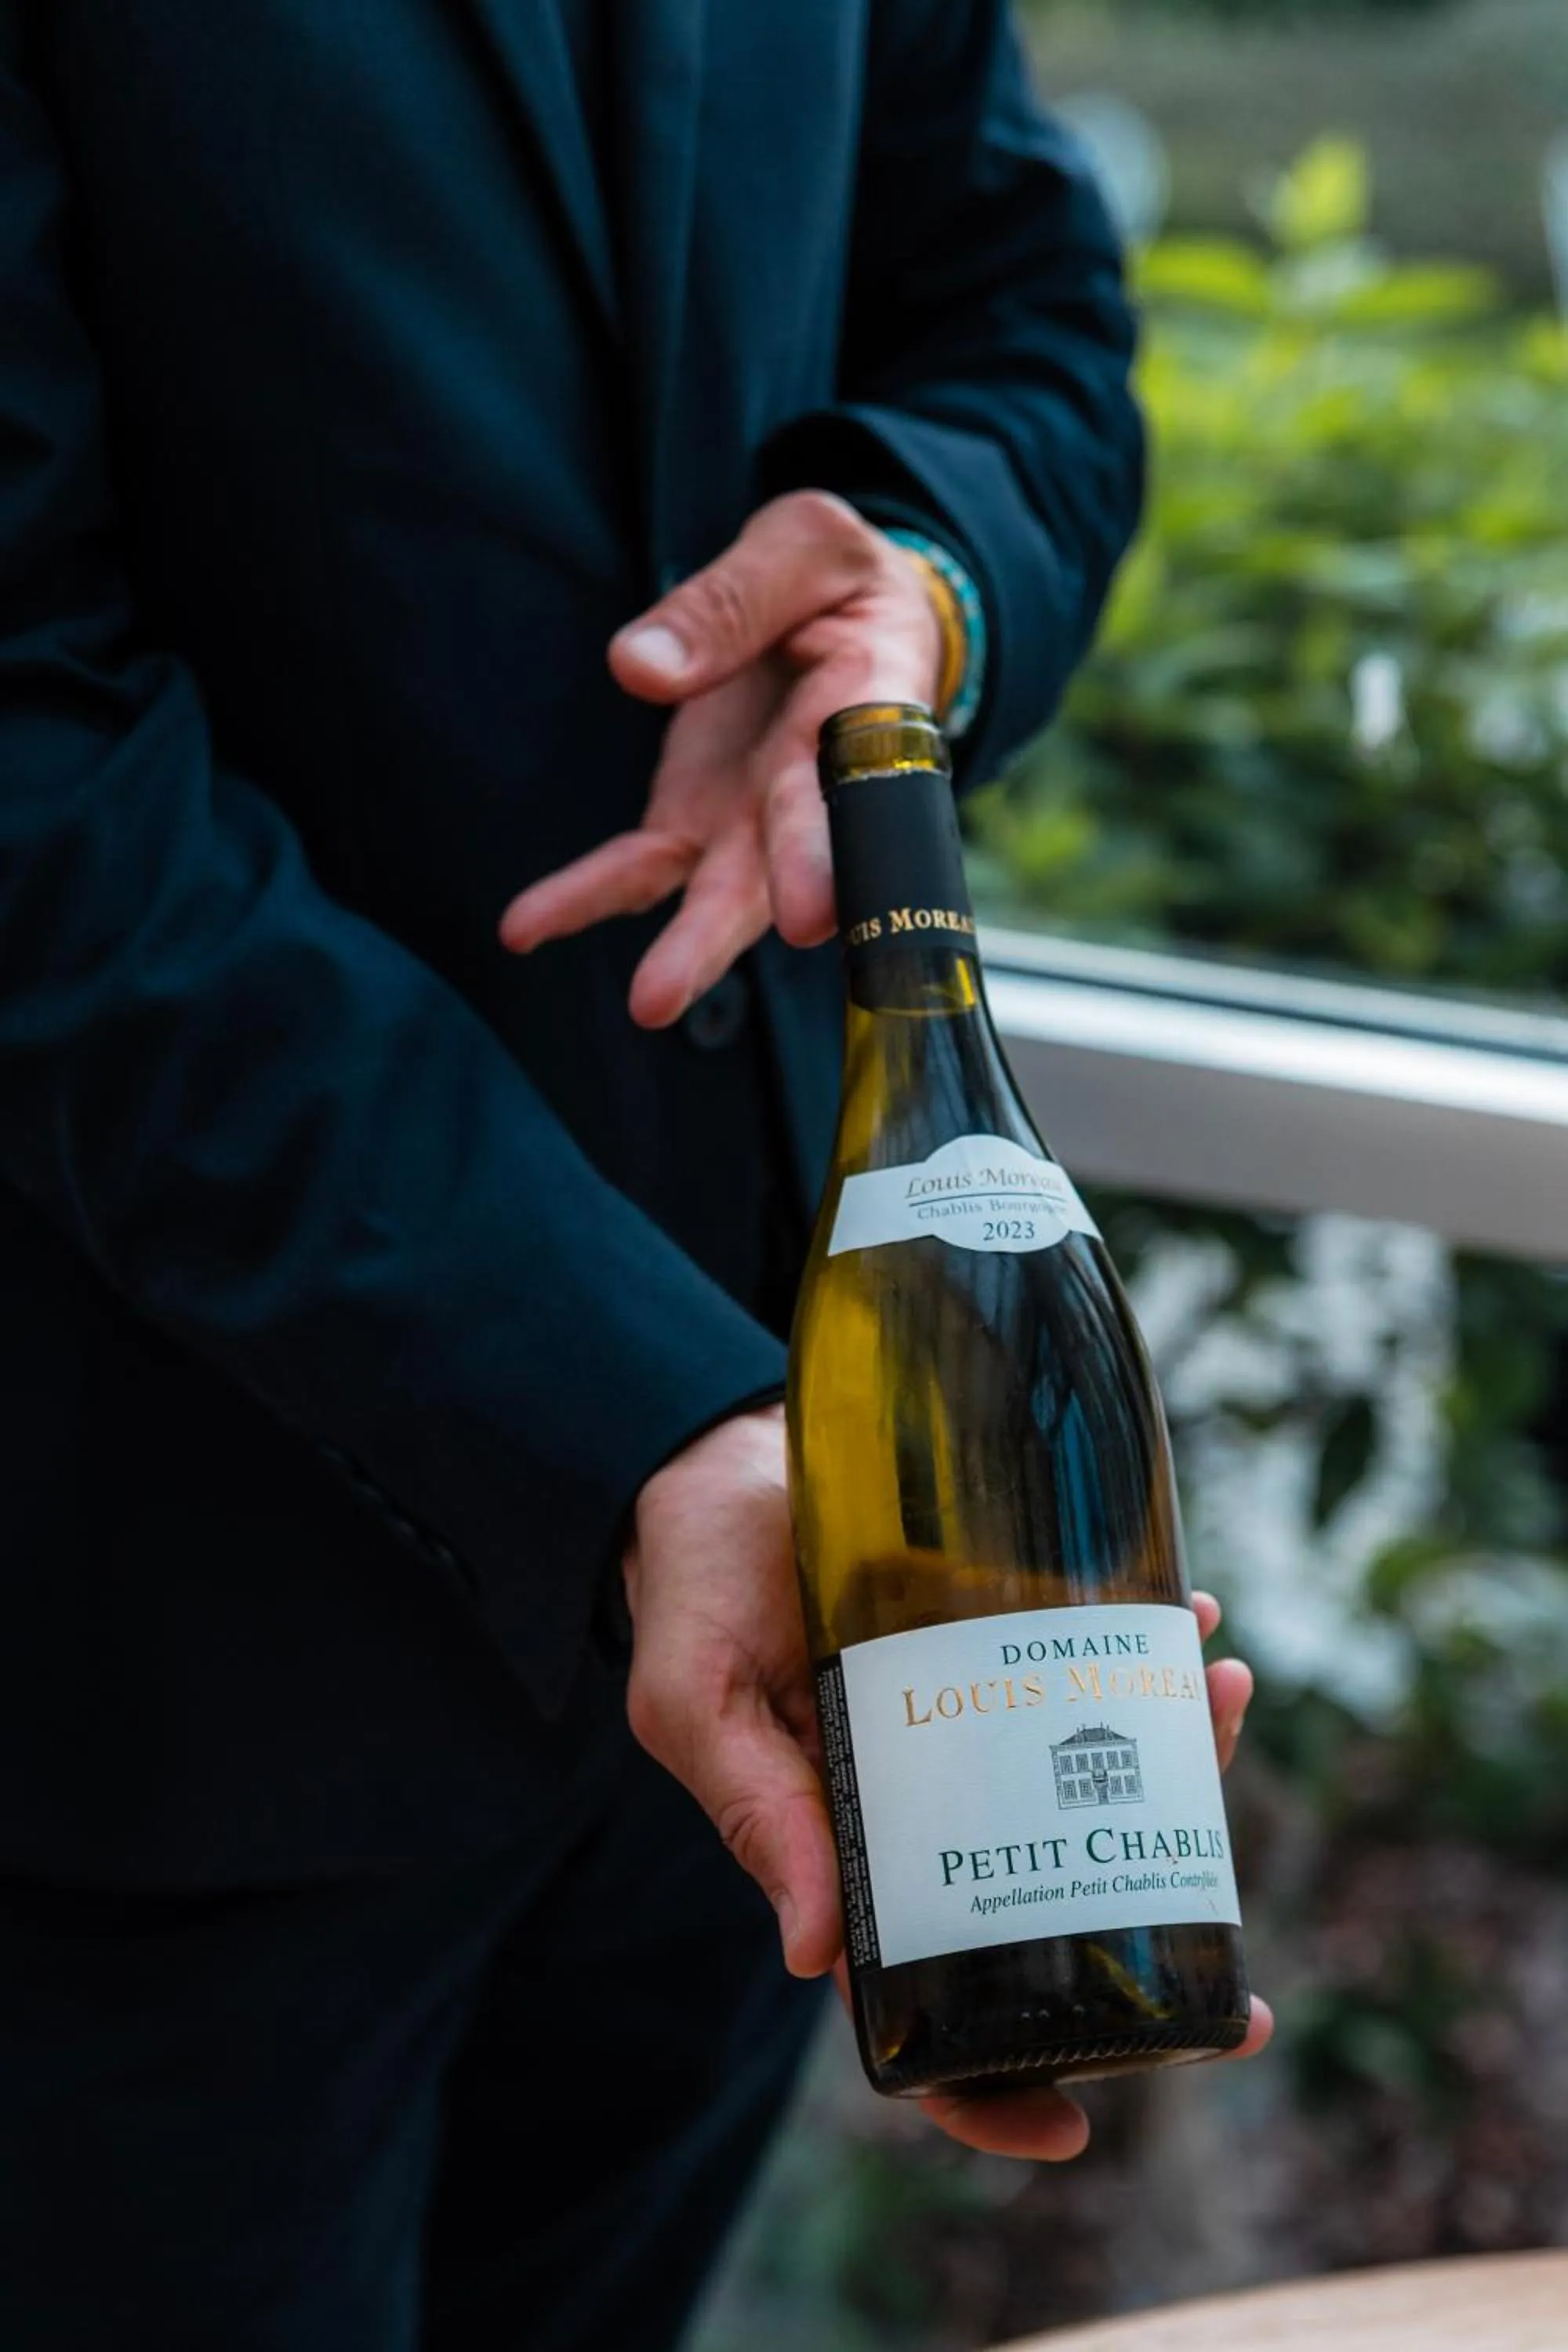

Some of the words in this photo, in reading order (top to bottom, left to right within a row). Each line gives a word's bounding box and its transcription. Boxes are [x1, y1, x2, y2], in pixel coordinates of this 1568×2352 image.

[849, 916, 882, 946] UIS
[905, 1171, 972, 1199] Louis
[916, 1201, 983, 1220] Chablis
[982, 1220, 1036, 1241] 2023
[1000, 1634, 1150, 1665] DOMAINE
[902, 1673, 1047, 1726] LOUIS
[938, 1838, 1068, 1887] PETIT
[1085, 1828, 1225, 1864] CHABLIS
[970, 1886, 1065, 1915] Appellation
[1070, 1878, 1107, 1898] Petit
[1112, 1872, 1167, 1894] Chablis
